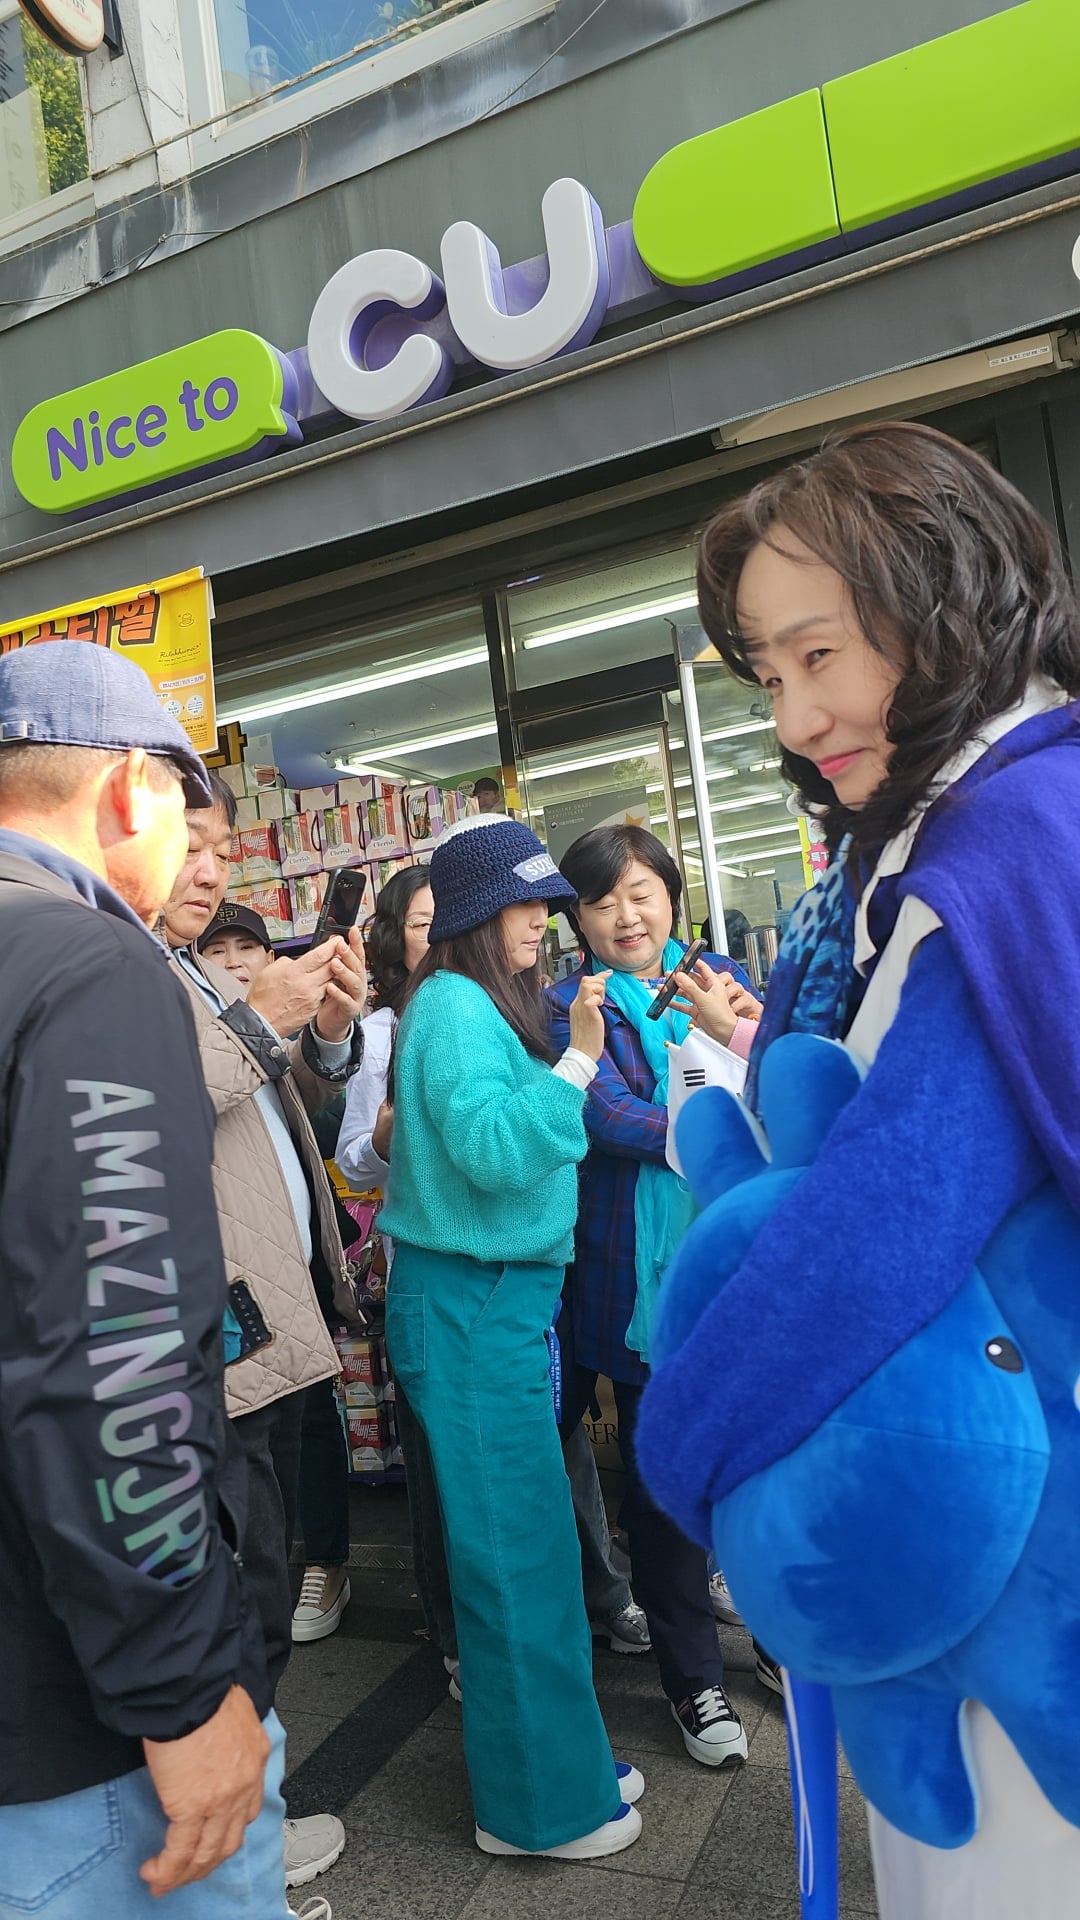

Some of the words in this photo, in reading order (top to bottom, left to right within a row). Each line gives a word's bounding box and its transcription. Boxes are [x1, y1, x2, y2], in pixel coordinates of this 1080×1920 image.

[307, 177, 604, 421] CU
[46, 403, 168, 481] Nice
[179, 376, 239, 433] to
[373, 839, 395, 848] Cherish
[330, 848, 352, 857] Cherish
[289, 856, 311, 865] Cherish
